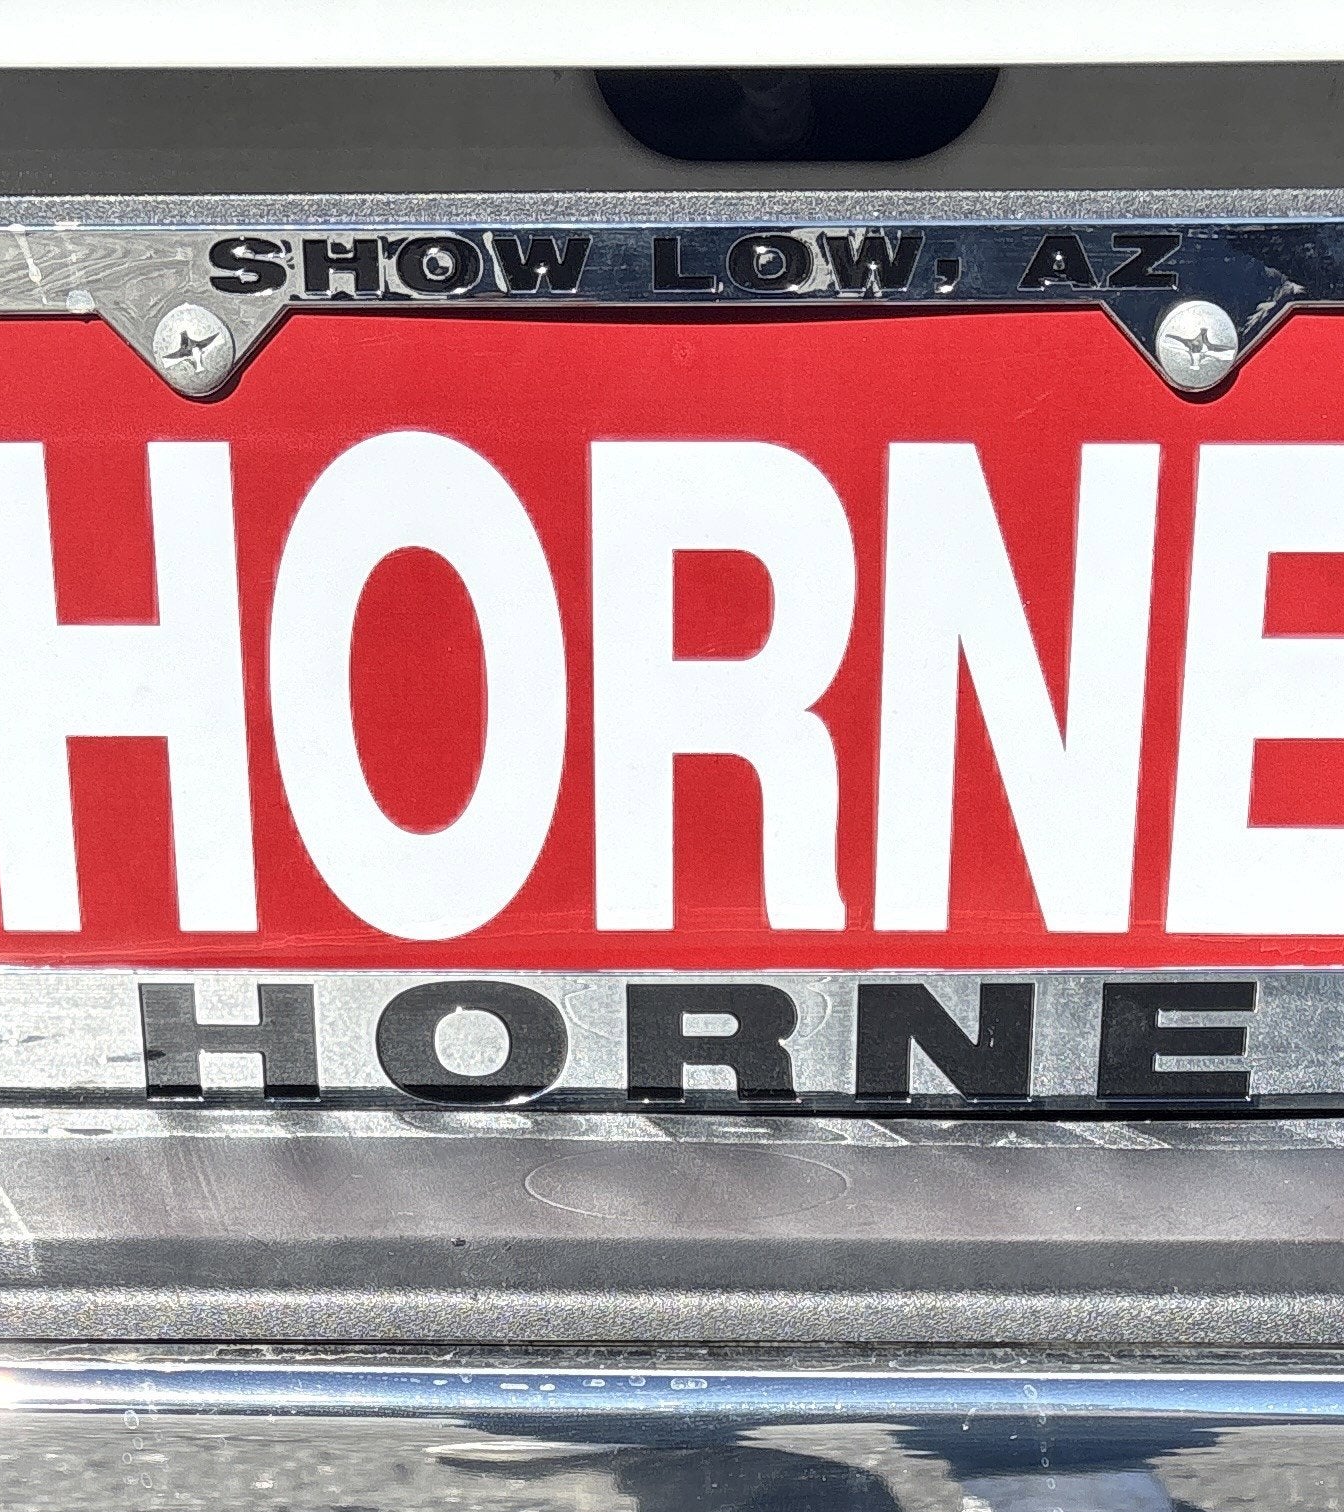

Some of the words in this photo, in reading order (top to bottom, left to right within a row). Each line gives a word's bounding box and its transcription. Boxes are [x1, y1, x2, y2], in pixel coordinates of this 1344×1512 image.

[208, 234, 592, 296] SHOW
[654, 233, 962, 296] LOW,
[1020, 233, 1184, 292] AZ
[137, 981, 1258, 1106] HORNE
